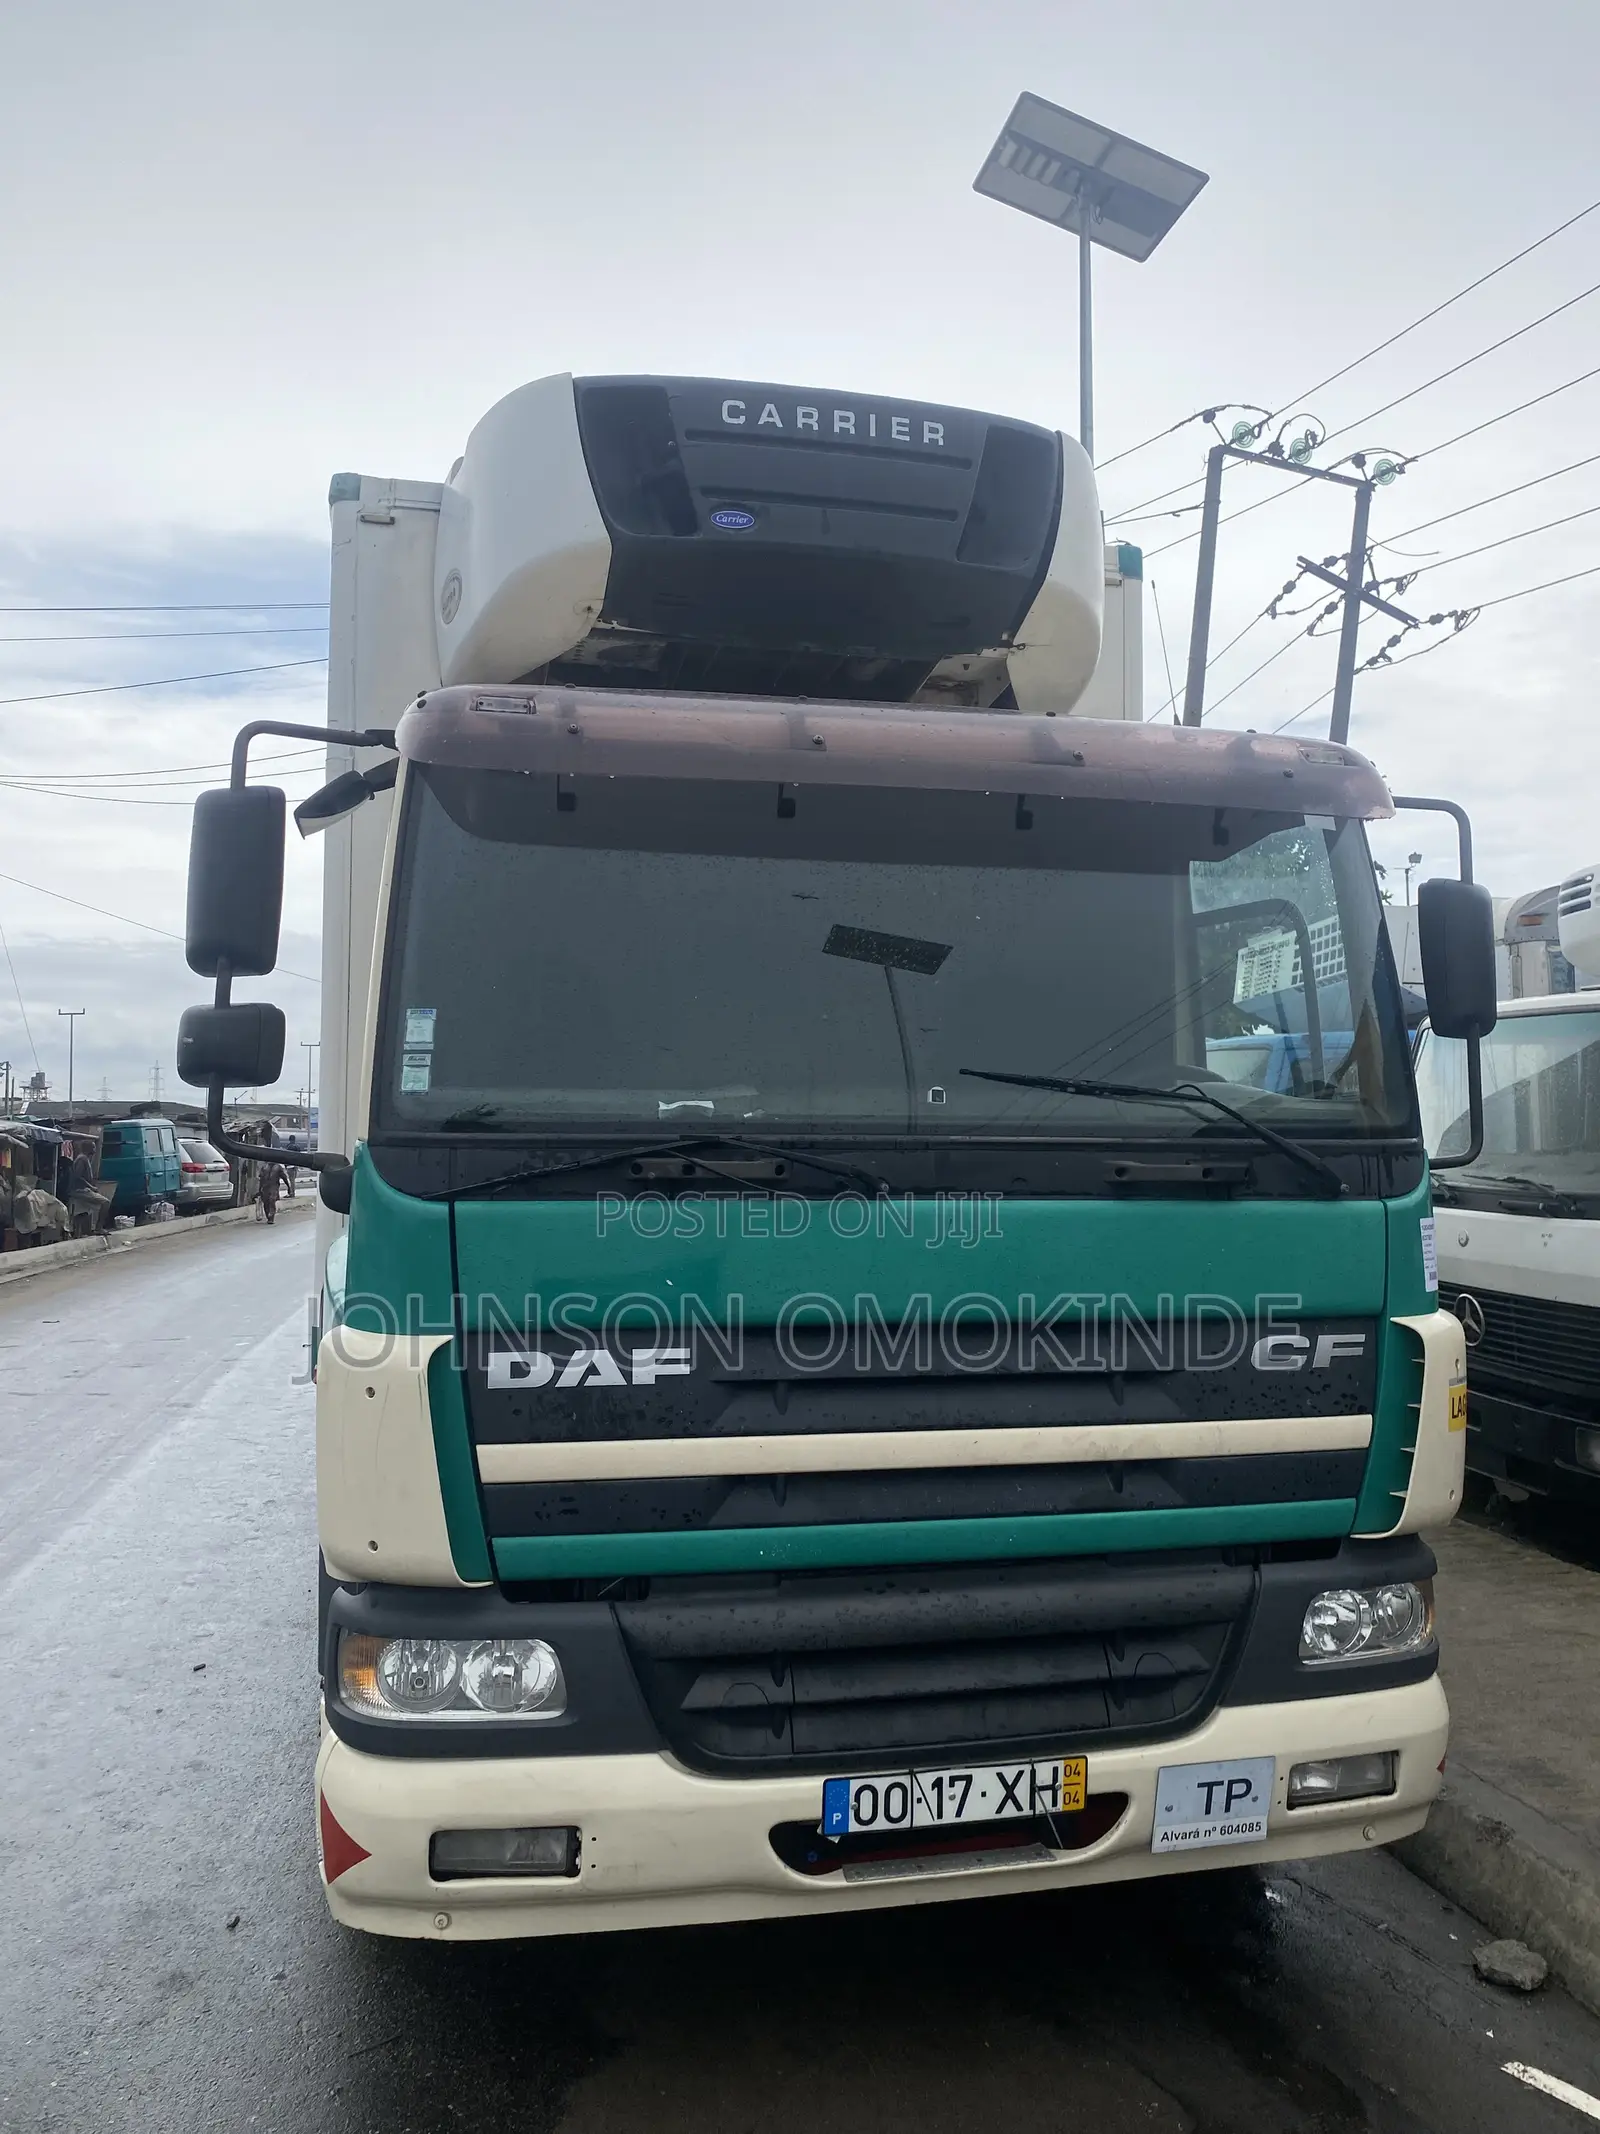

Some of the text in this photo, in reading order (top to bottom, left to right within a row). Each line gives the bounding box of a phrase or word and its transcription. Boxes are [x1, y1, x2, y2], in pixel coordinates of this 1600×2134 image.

[721, 399, 944, 446] CARRIER
[716, 514, 749, 525] Carrier
[1250, 1333, 1366, 1371] CF
[487, 1347, 691, 1389] DAF
[1063, 1762, 1081, 1778] 04
[1063, 1790, 1080, 1806] 04
[1197, 1778, 1252, 1815] TP
[832, 1812, 842, 1825] P
[1160, 1828, 1200, 1843] Alvará
[1219, 1821, 1261, 1836] 604085
